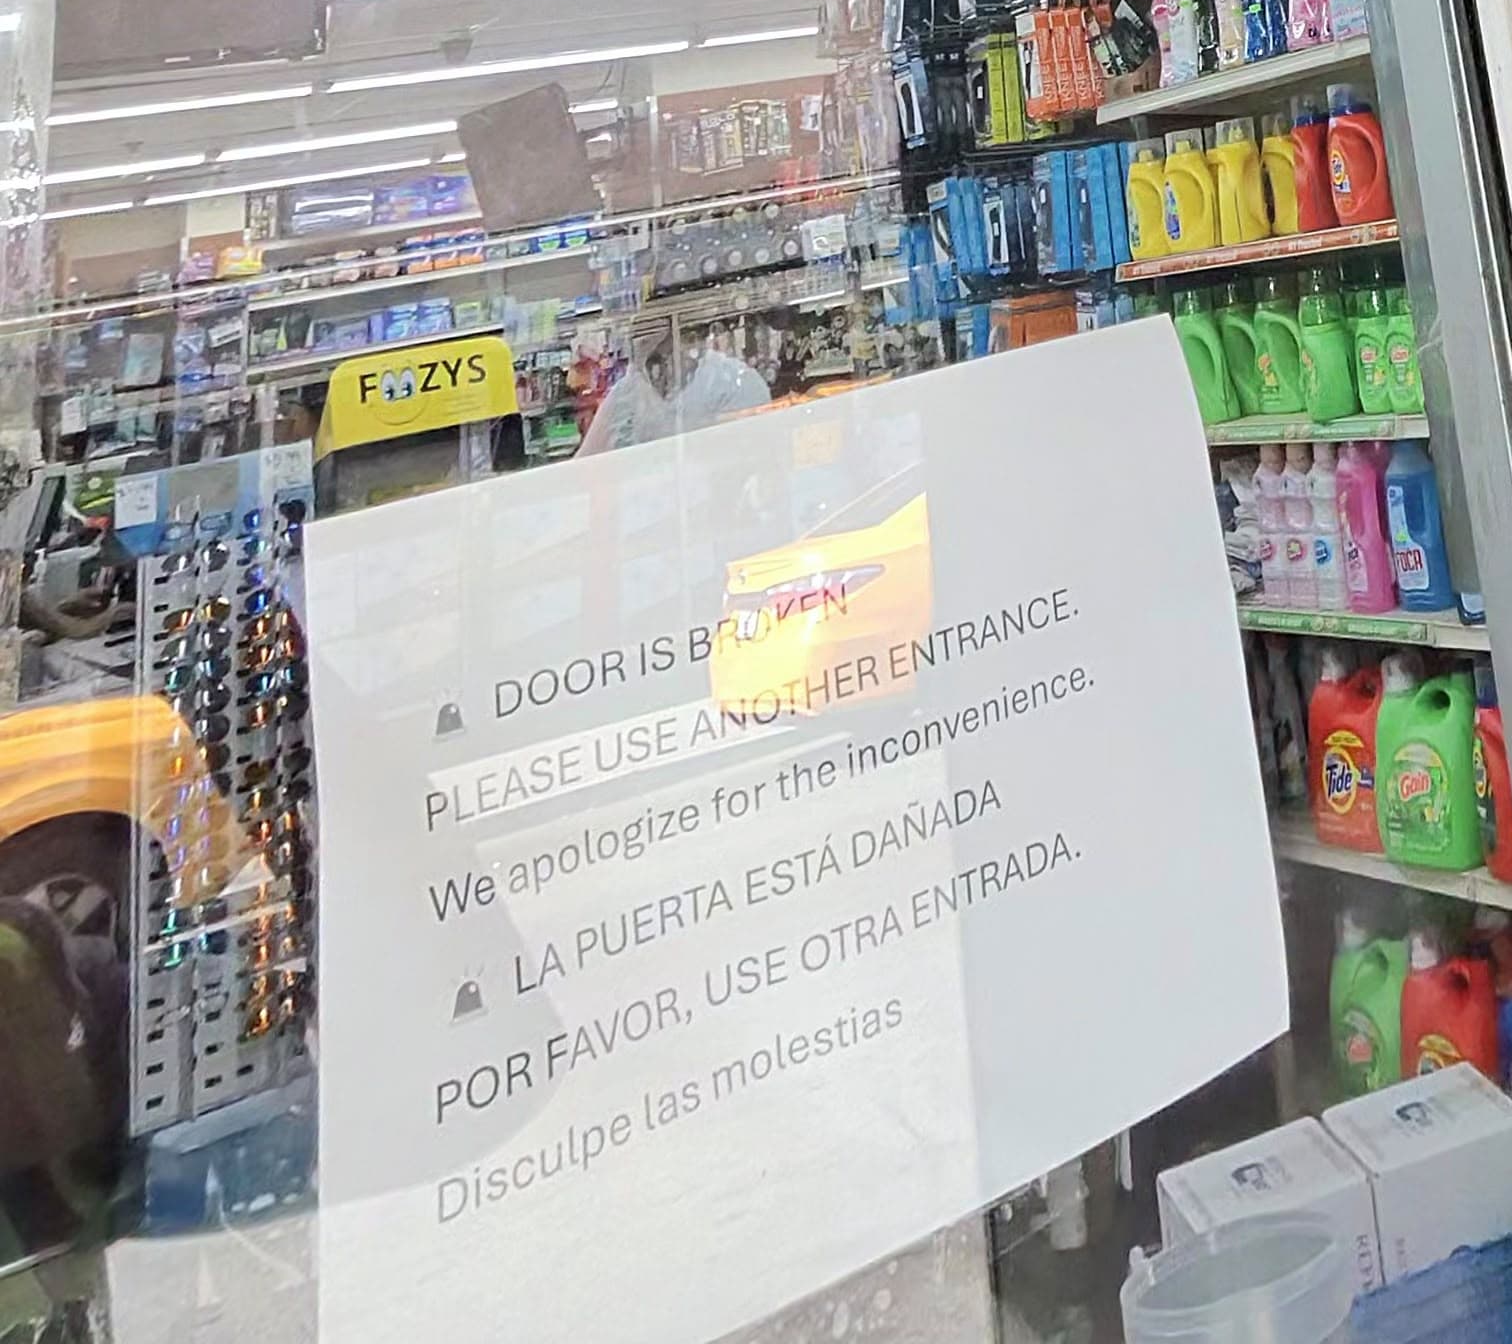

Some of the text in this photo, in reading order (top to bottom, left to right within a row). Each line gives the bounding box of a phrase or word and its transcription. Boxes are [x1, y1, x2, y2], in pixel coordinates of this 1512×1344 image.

[426, 589, 1080, 832] PLEASE USE ANOTHER ENTRANCE.
[496, 650, 627, 718] DOOR
[639, 636, 675, 676] IS
[1326, 762, 1353, 798] Tide
[1399, 771, 1431, 801] Gain
[429, 666, 1095, 922] We apologize for the inconvenience.
[515, 779, 1001, 995] LA PUERTA ESTÁ DAÑADA
[436, 832, 1082, 1125] POR FAVOR, USE OTRA ENTRADA.
[437, 997, 904, 1224] Disculpe las molestias
